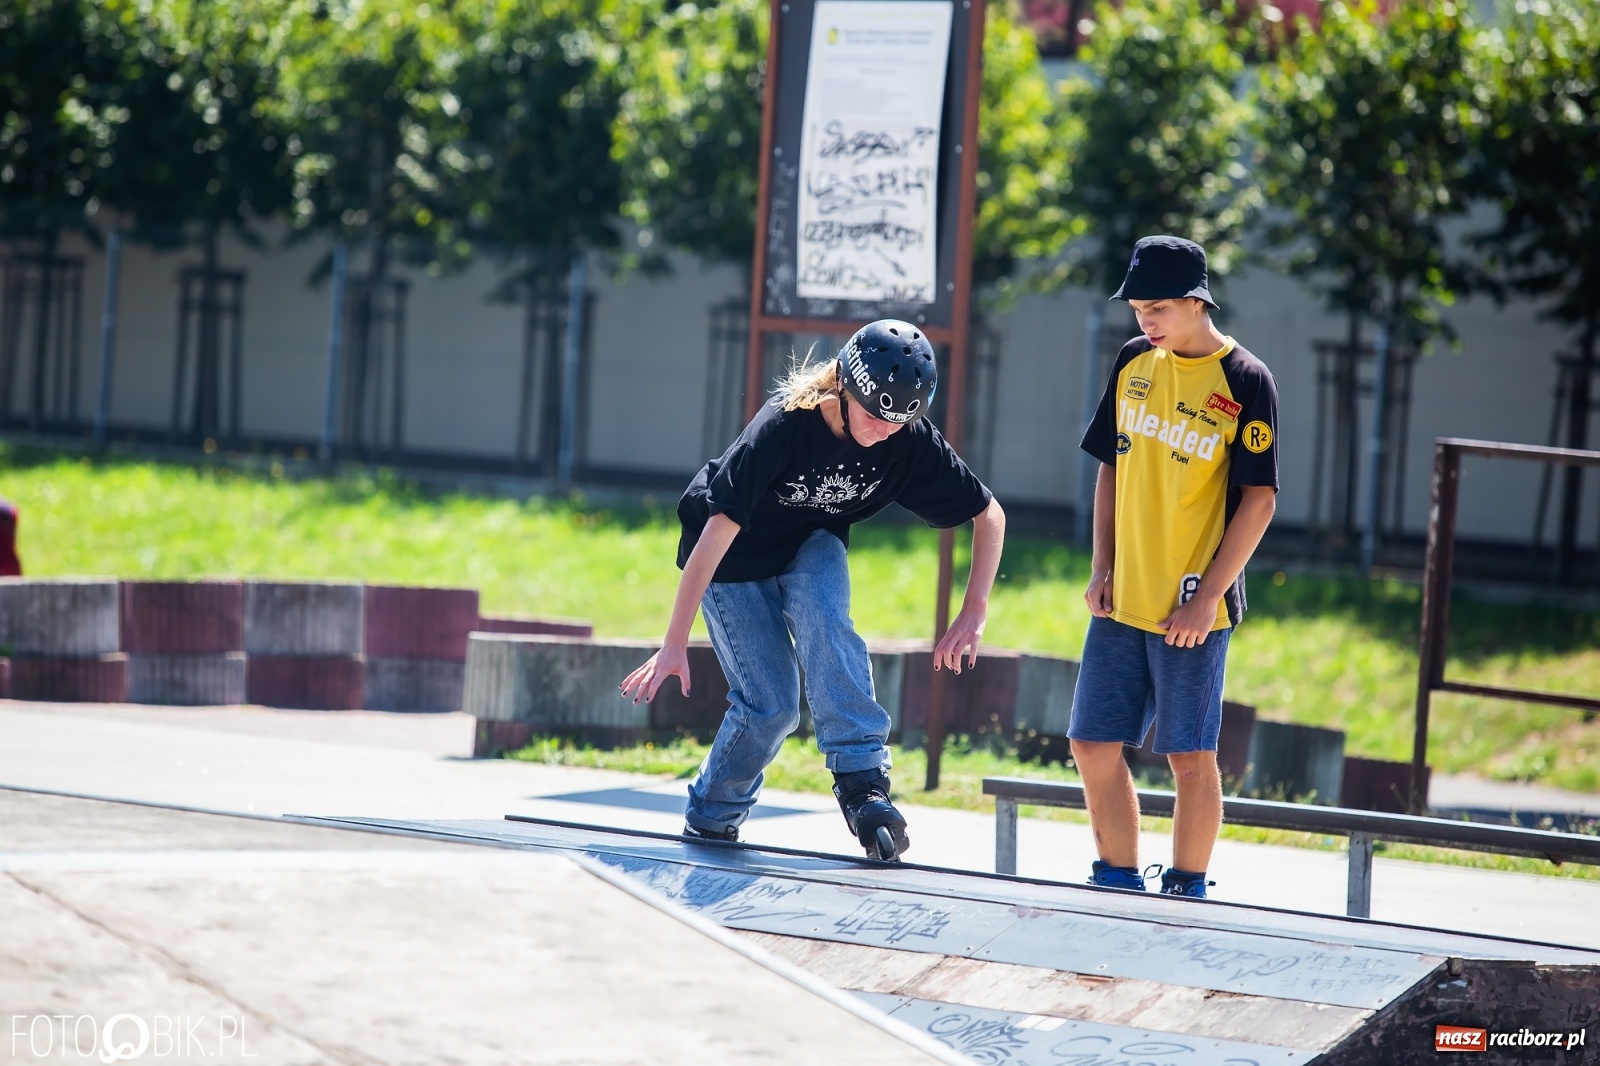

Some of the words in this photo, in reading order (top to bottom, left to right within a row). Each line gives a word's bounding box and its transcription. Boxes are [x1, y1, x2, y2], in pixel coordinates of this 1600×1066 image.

[847, 344, 876, 396] etnies
[1130, 380, 1149, 390] MOTOR
[1175, 402, 1198, 420] Racing
[1198, 410, 1218, 427] Team
[1171, 451, 1190, 465] Fuel
